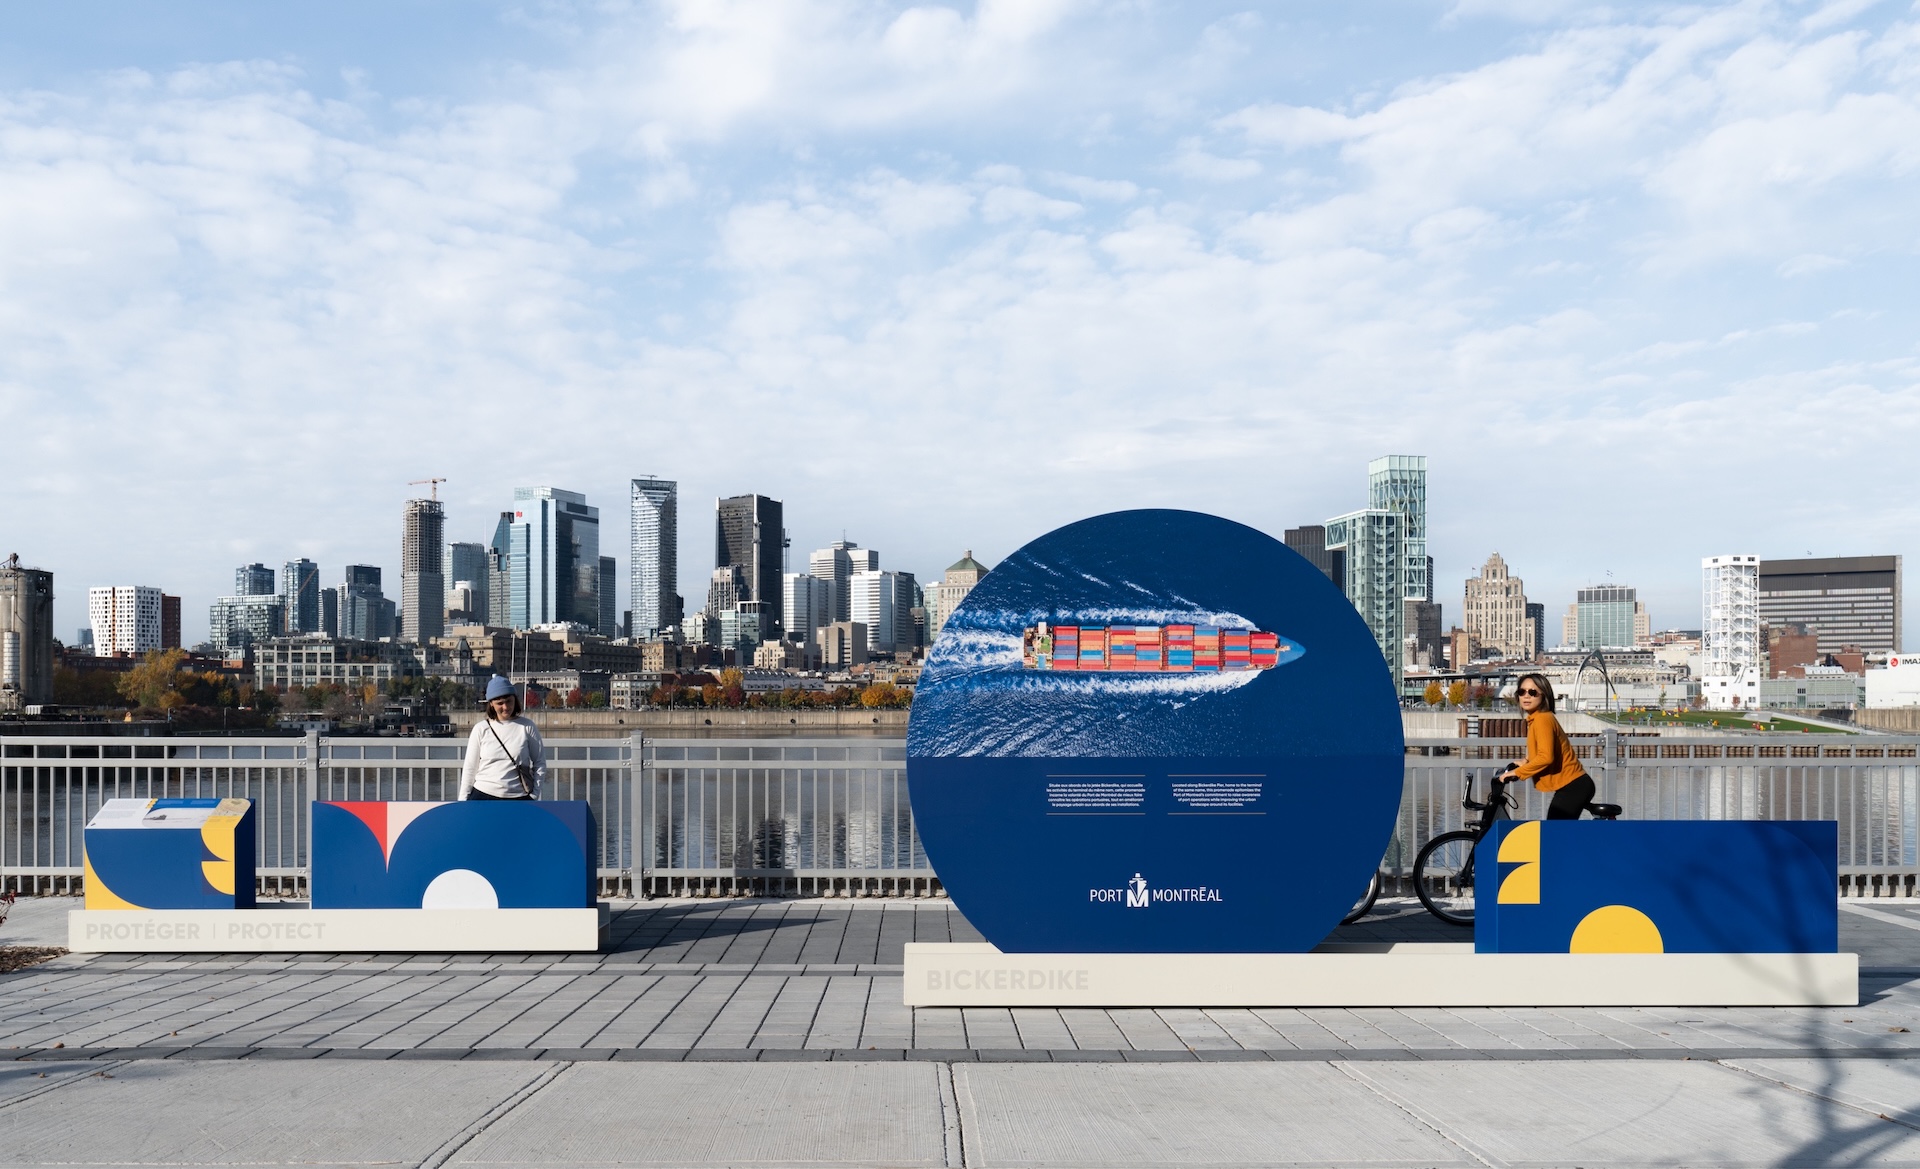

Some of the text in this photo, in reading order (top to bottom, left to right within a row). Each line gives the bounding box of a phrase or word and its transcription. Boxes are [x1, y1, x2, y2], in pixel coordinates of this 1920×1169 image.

[1090, 889, 1123, 902] PORT
[86, 919, 326, 940] PROTÉGER PROTECT
[927, 969, 1089, 991] BICKERDIKE
